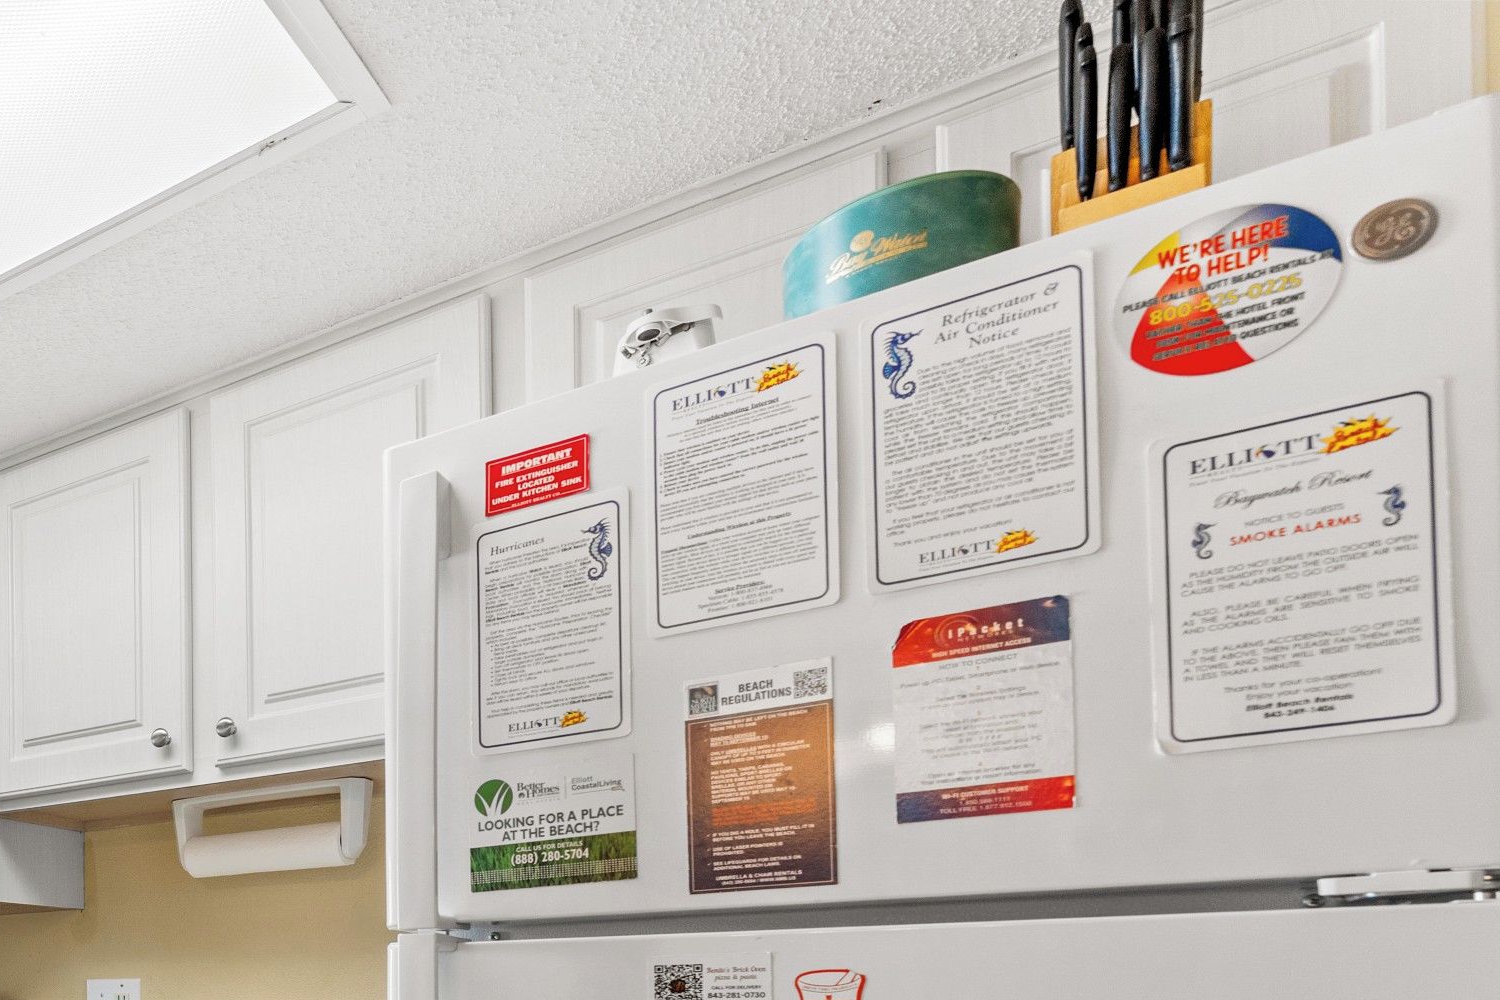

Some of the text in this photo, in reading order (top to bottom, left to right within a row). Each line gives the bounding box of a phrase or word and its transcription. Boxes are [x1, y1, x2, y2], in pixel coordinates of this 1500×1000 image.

[1158, 215, 1288, 268] WE'RE HERE
[1175, 244, 1269, 284] TO HELP!
[1123, 297, 1158, 314] PLEASE
[1161, 290, 1186, 303] CALL
[1188, 278, 1228, 297] ELLIOTT
[1231, 268, 1265, 285] BEACH
[1268, 255, 1315, 274] RENTALS
[942, 282, 1059, 327] Refrigerator &
[1149, 272, 1303, 325] 800-525-0225
[1236, 303, 1269, 316] HOTEL
[1271, 292, 1305, 308] FRONT
[934, 301, 1060, 344] Air Conditioner
[1279, 306, 1295, 318] OR
[968, 326, 1020, 349] Notice
[696, 396, 780, 426] Troubleshooting Internet
[501, 448, 572, 475] IMPORTANT
[495, 460, 578, 488] FIRE EXTINGUISHER
[517, 475, 554, 490] LOCATED
[492, 476, 582, 506] UNDER KITCHEN SINK
[1213, 480, 1301, 510] Baywatch
[1307, 469, 1373, 491] Resort
[1244, 501, 1345, 528] NOTICE TO GUESTS
[1229, 513, 1362, 547] SMOKE ALARMS
[490, 537, 545, 556] Hurricanes
[949, 647, 970, 656] SPEED
[971, 642, 1003, 652] INTERNET
[1005, 637, 1031, 647] ACCESS
[975, 653, 1018, 665] CONNECT
[721, 687, 792, 706] REGULATIONS
[738, 679, 773, 693] BEACH
[517, 782, 546, 792] Better
[571, 776, 593, 784] Elliott
[571, 779, 622, 791] CoastalLiving
[525, 785, 560, 799] Homes
[478, 805, 624, 832] LOOKING FOR A PLACE
[502, 820, 600, 842] AT THE BEACH?
[557, 840, 583, 849] DETAILS
[510, 848, 589, 867] (888) 280-5704
